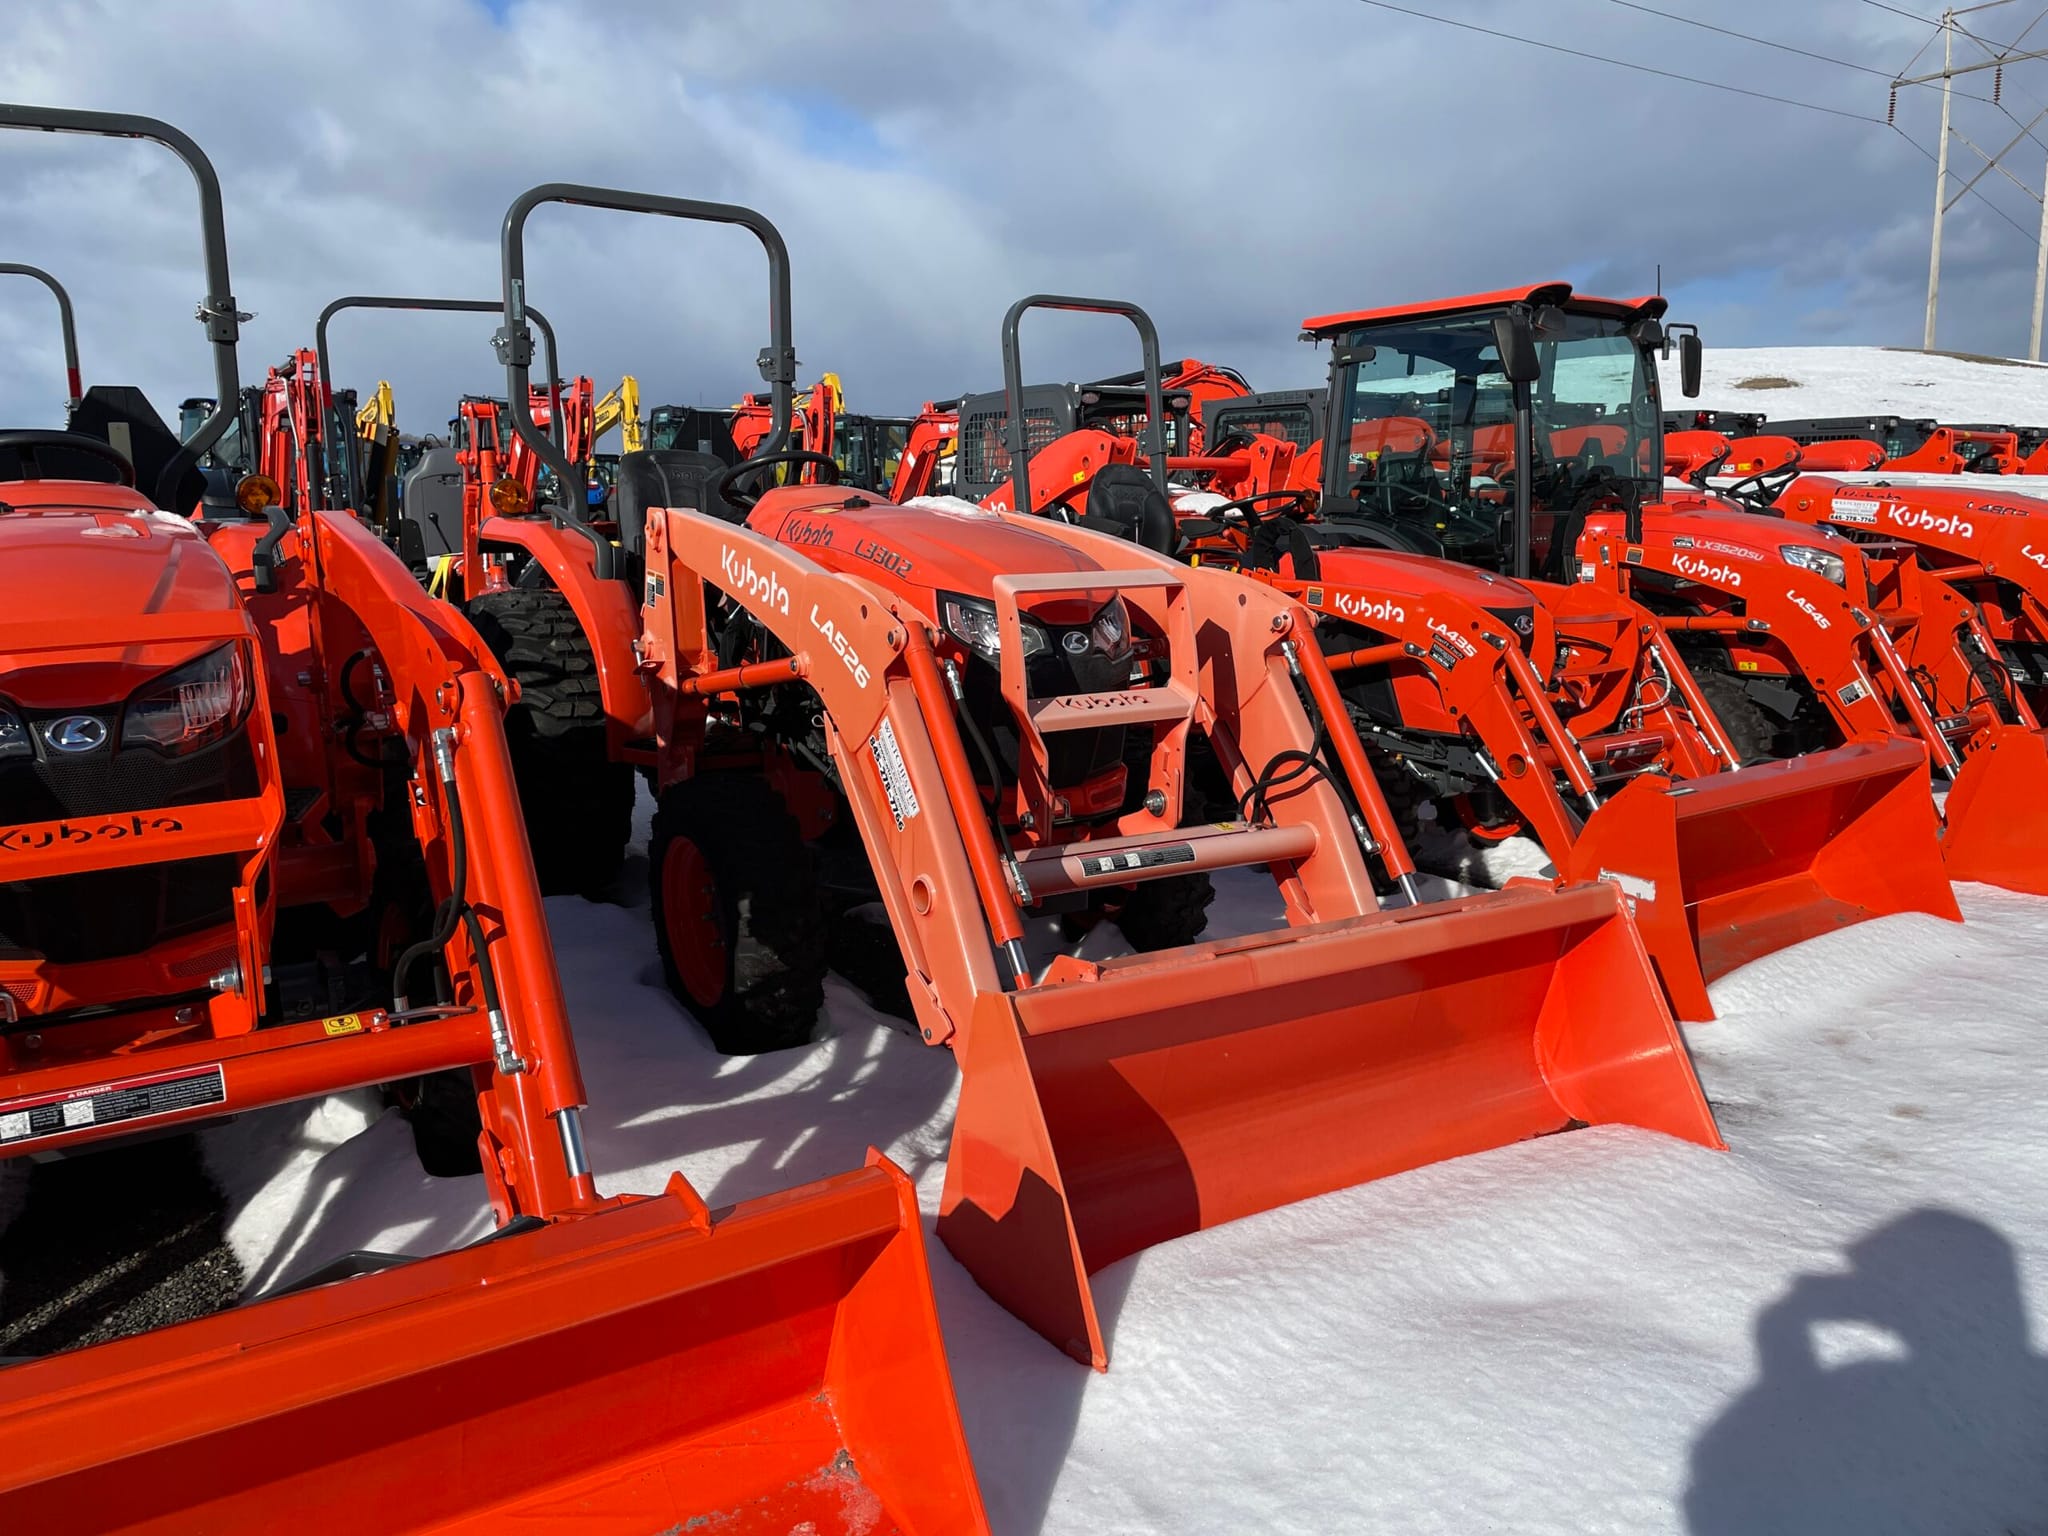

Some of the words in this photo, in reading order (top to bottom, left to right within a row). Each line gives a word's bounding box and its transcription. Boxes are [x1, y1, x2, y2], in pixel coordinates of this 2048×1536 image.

[786, 519, 833, 546] Kubota
[854, 539, 913, 579] L3302
[1888, 504, 1973, 538] Kubota
[2021, 544, 2048, 569] LA
[722, 544, 790, 616] Kubota
[810, 603, 871, 689] LA526
[1672, 553, 1741, 587] Kubota
[1786, 589, 1831, 629] LA545
[1335, 592, 1405, 623] Kubota
[1426, 616, 1478, 657] LA435
[1055, 692, 1152, 711] Kubota
[869, 735, 905, 831] 845-278-7766
[883, 720, 917, 811] WESTCHESTER
[0, 815, 183, 851] Kubota
[76, 1085, 112, 1098] DANGER
